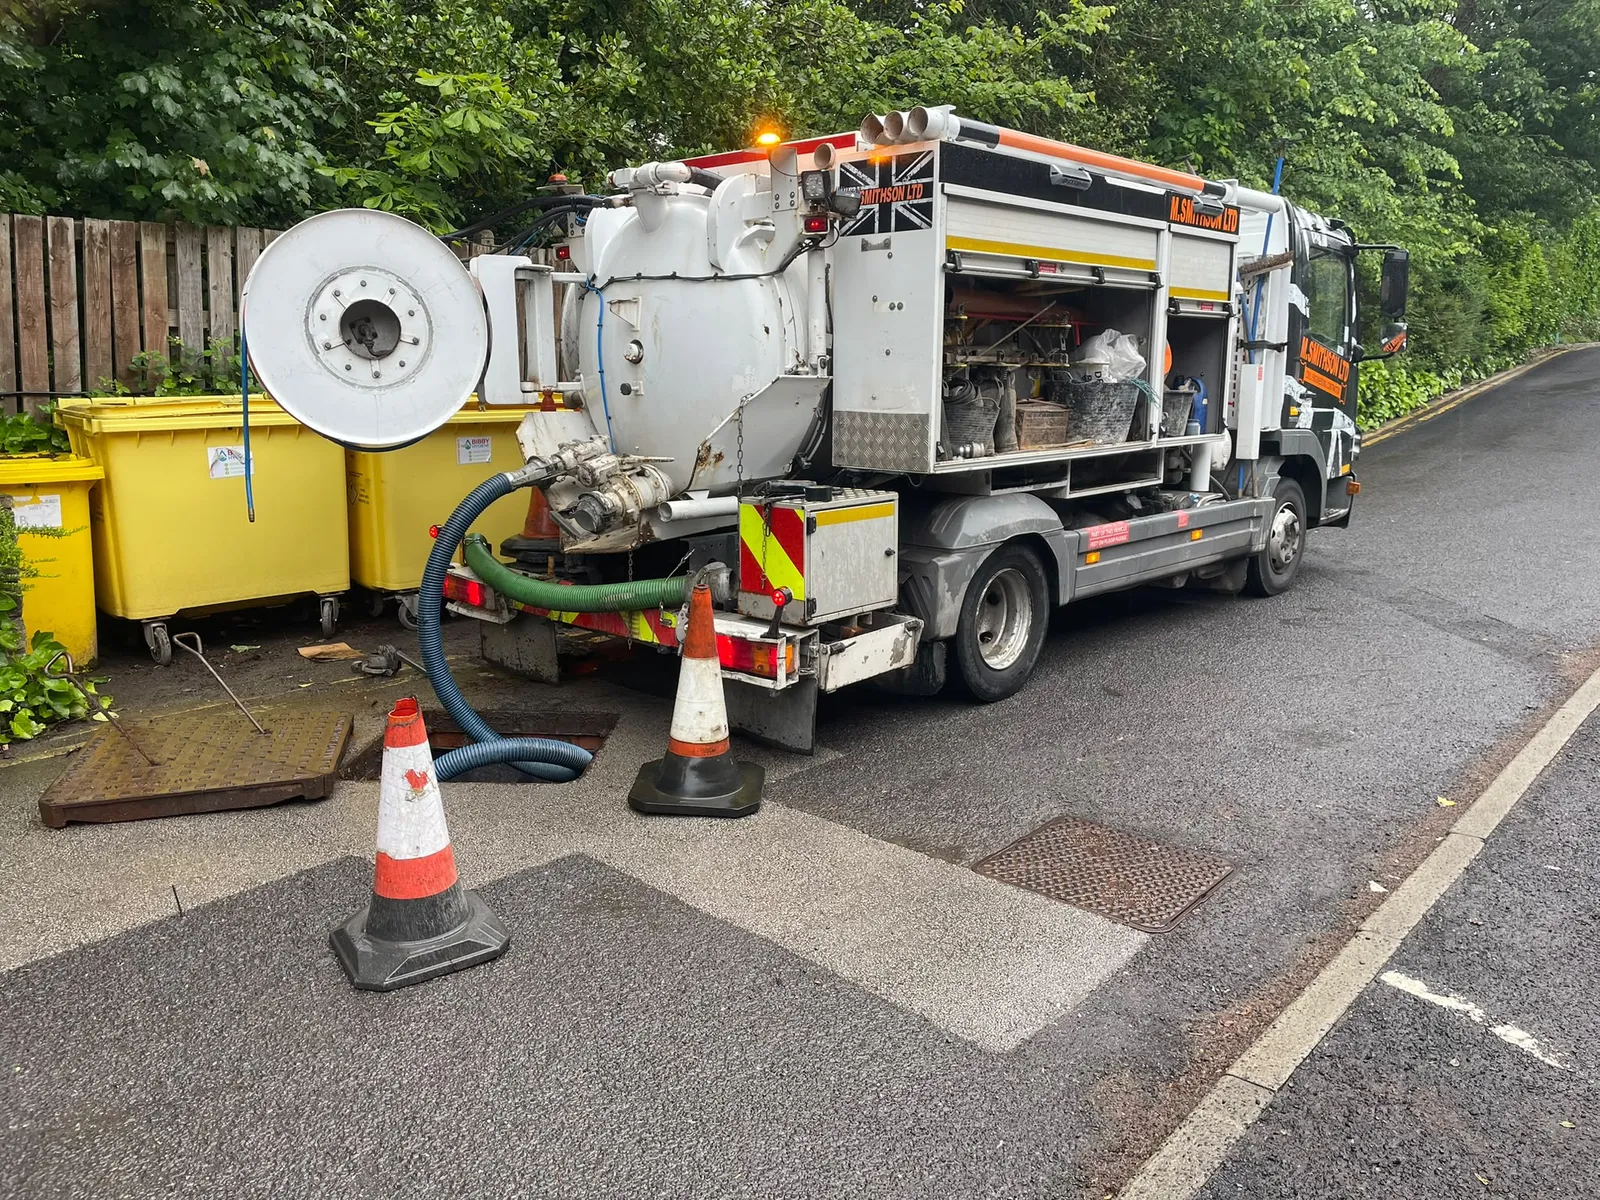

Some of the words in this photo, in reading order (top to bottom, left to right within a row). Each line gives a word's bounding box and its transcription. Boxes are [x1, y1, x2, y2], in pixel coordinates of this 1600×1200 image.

[906, 183, 924, 200] LTD
[1223, 207, 1238, 232] LTD
[1338, 358, 1350, 383] LTD
